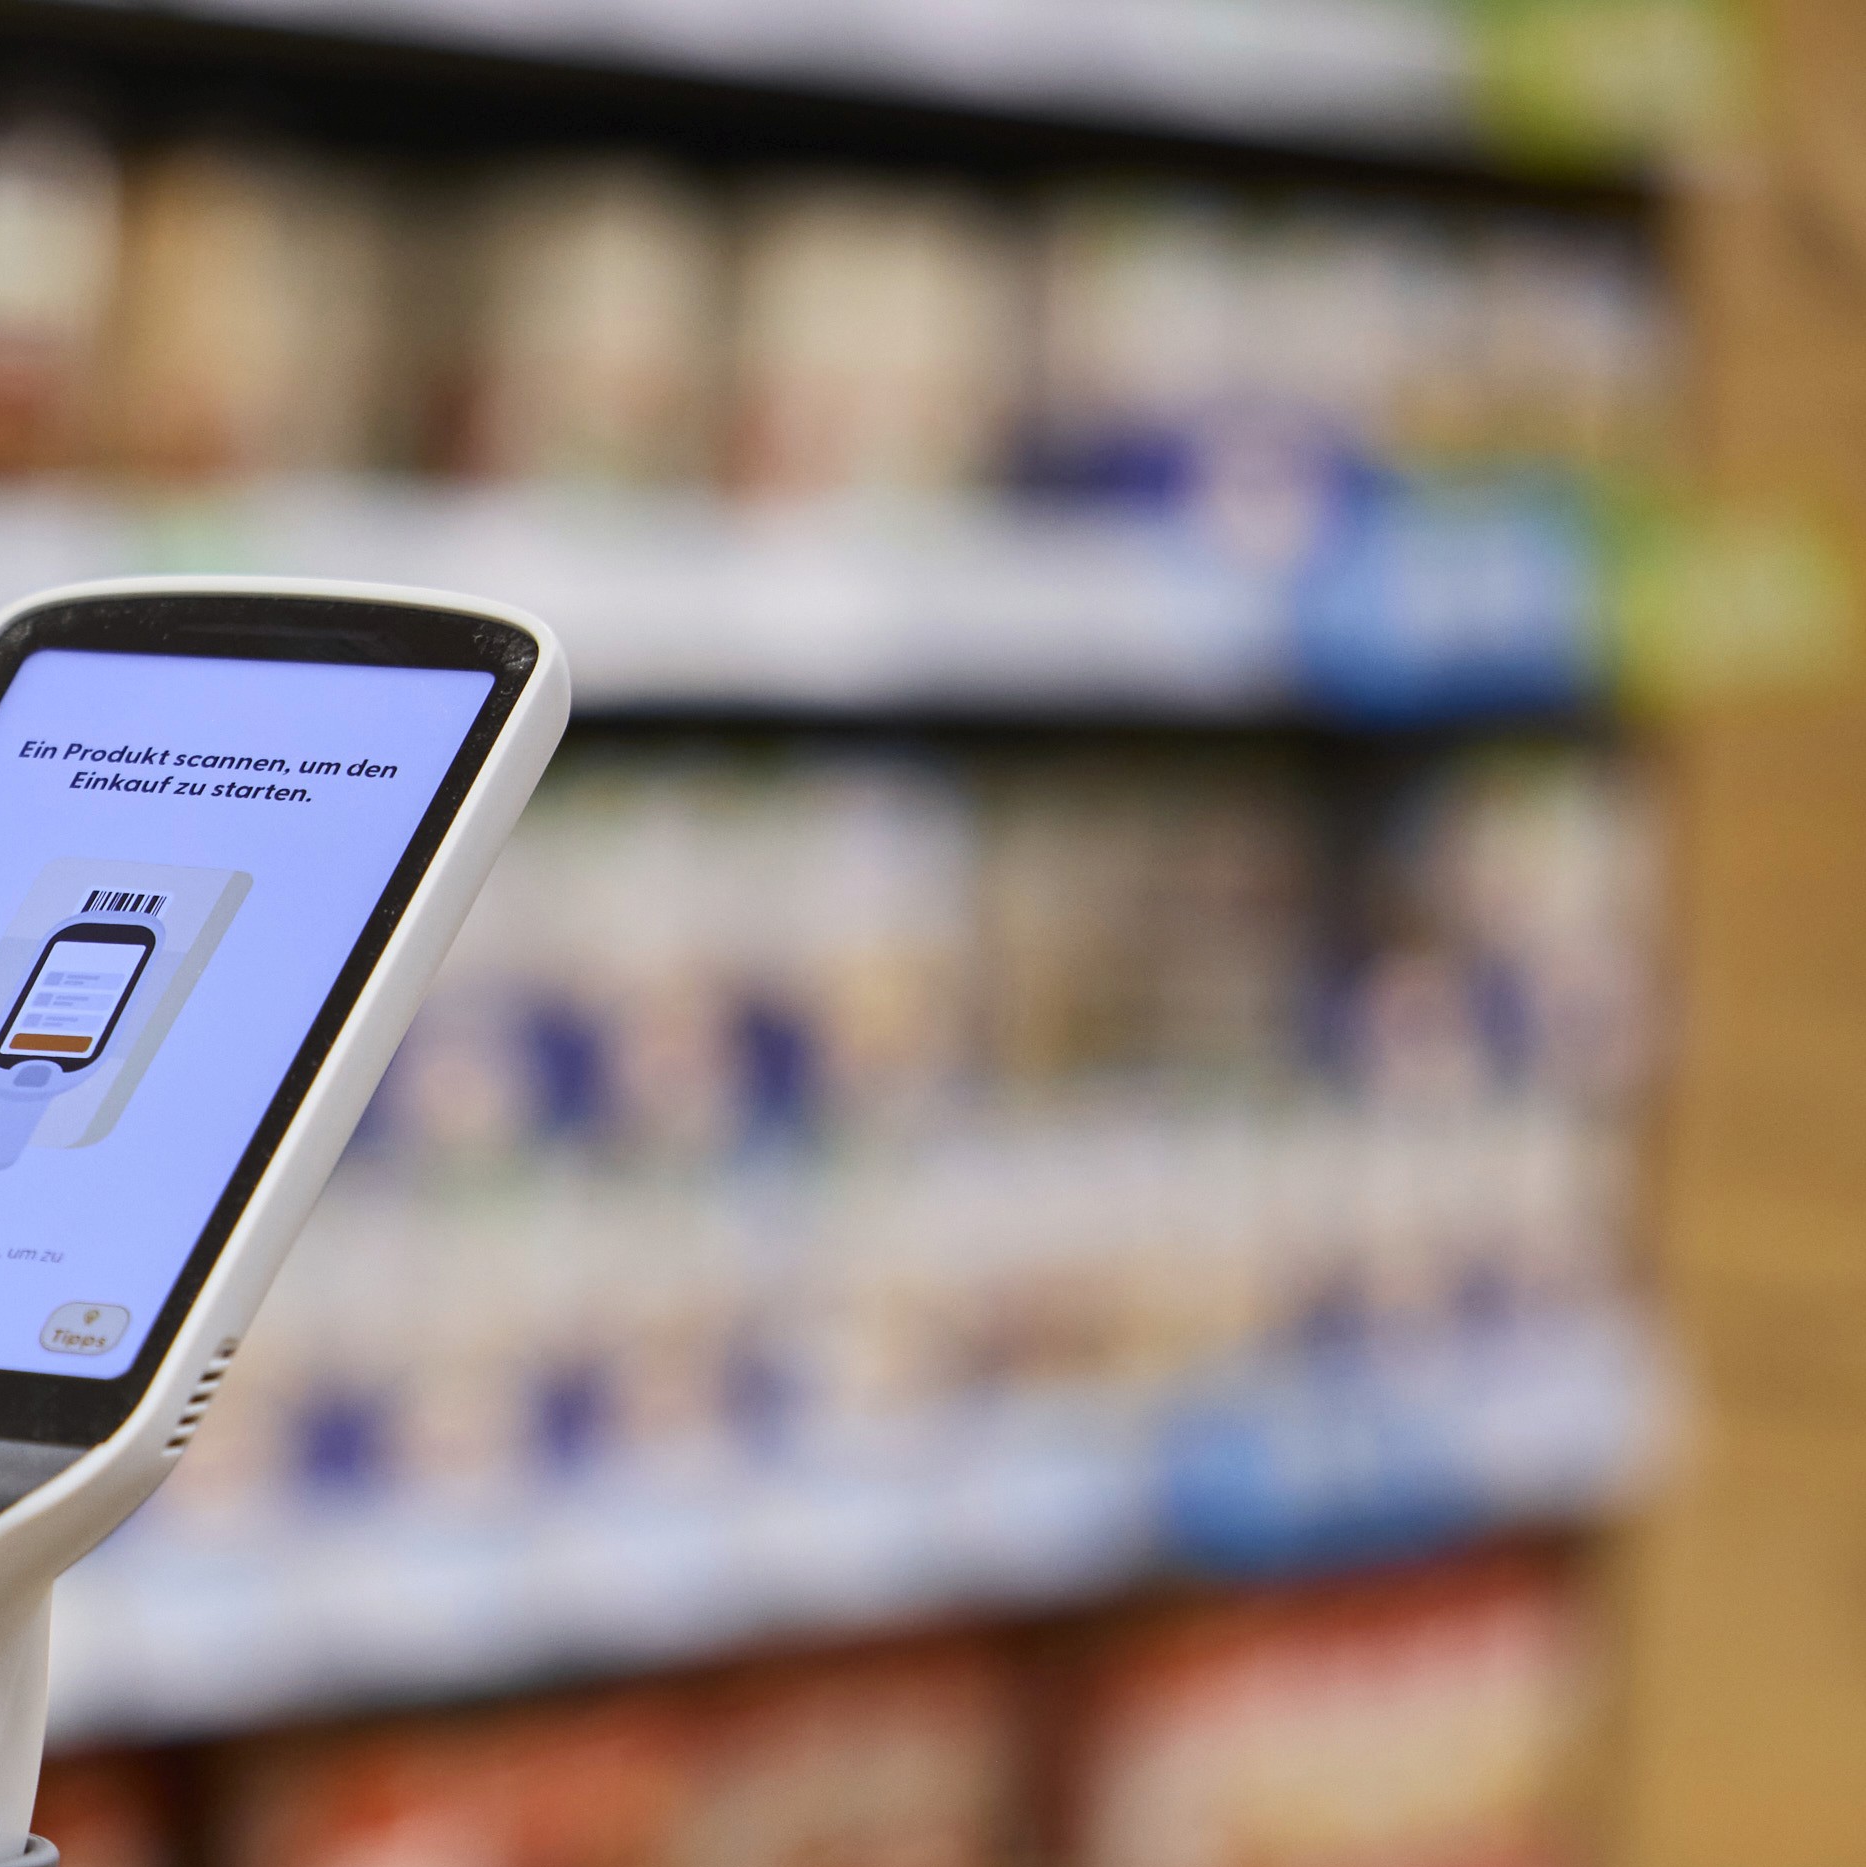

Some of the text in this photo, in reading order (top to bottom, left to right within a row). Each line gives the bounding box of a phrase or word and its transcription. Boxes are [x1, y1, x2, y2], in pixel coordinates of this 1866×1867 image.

[18, 741, 398, 779] Ein Produkt scannen, um den
[69, 771, 313, 802] Einkauf zu starten.
[8, 1247, 37, 1260] um
[41, 1250, 64, 1264] zu
[51, 1328, 107, 1348] Tipps
